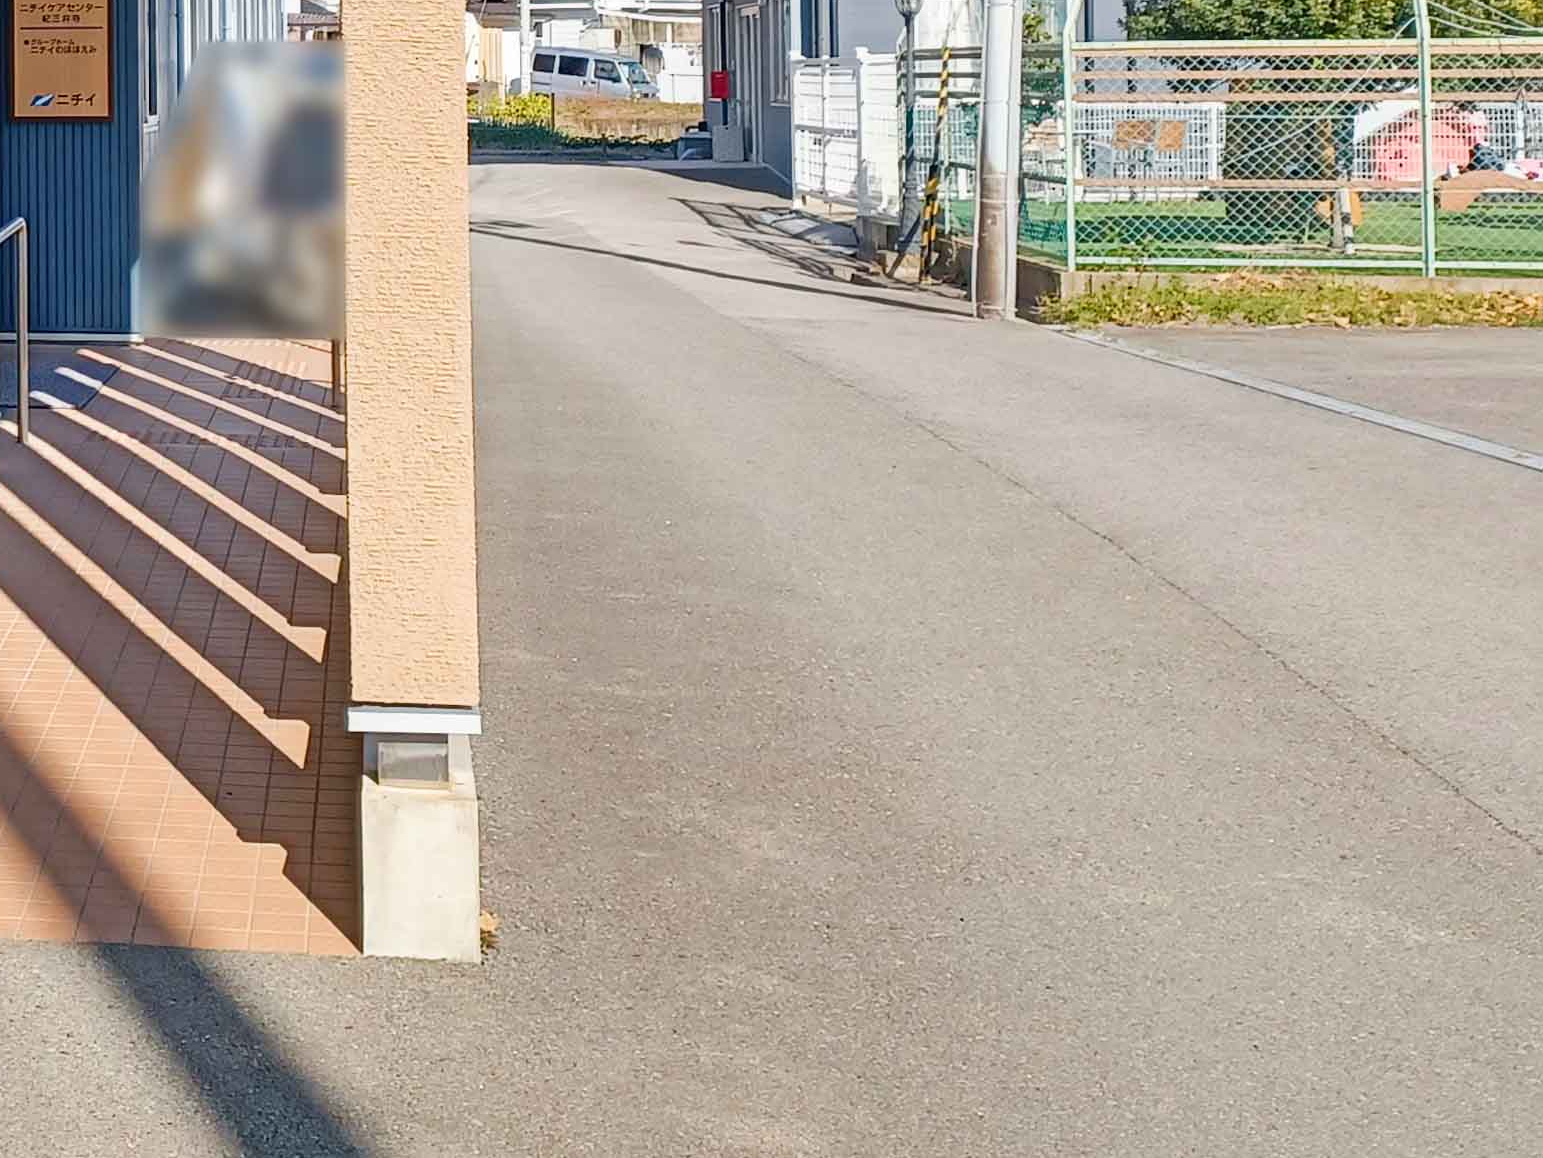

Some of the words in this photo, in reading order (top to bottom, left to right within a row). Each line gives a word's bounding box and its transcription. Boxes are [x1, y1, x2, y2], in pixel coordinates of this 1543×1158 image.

[19, 2, 104, 13] ニチイケアセンター
[56, 92, 97, 106] ニチイ
